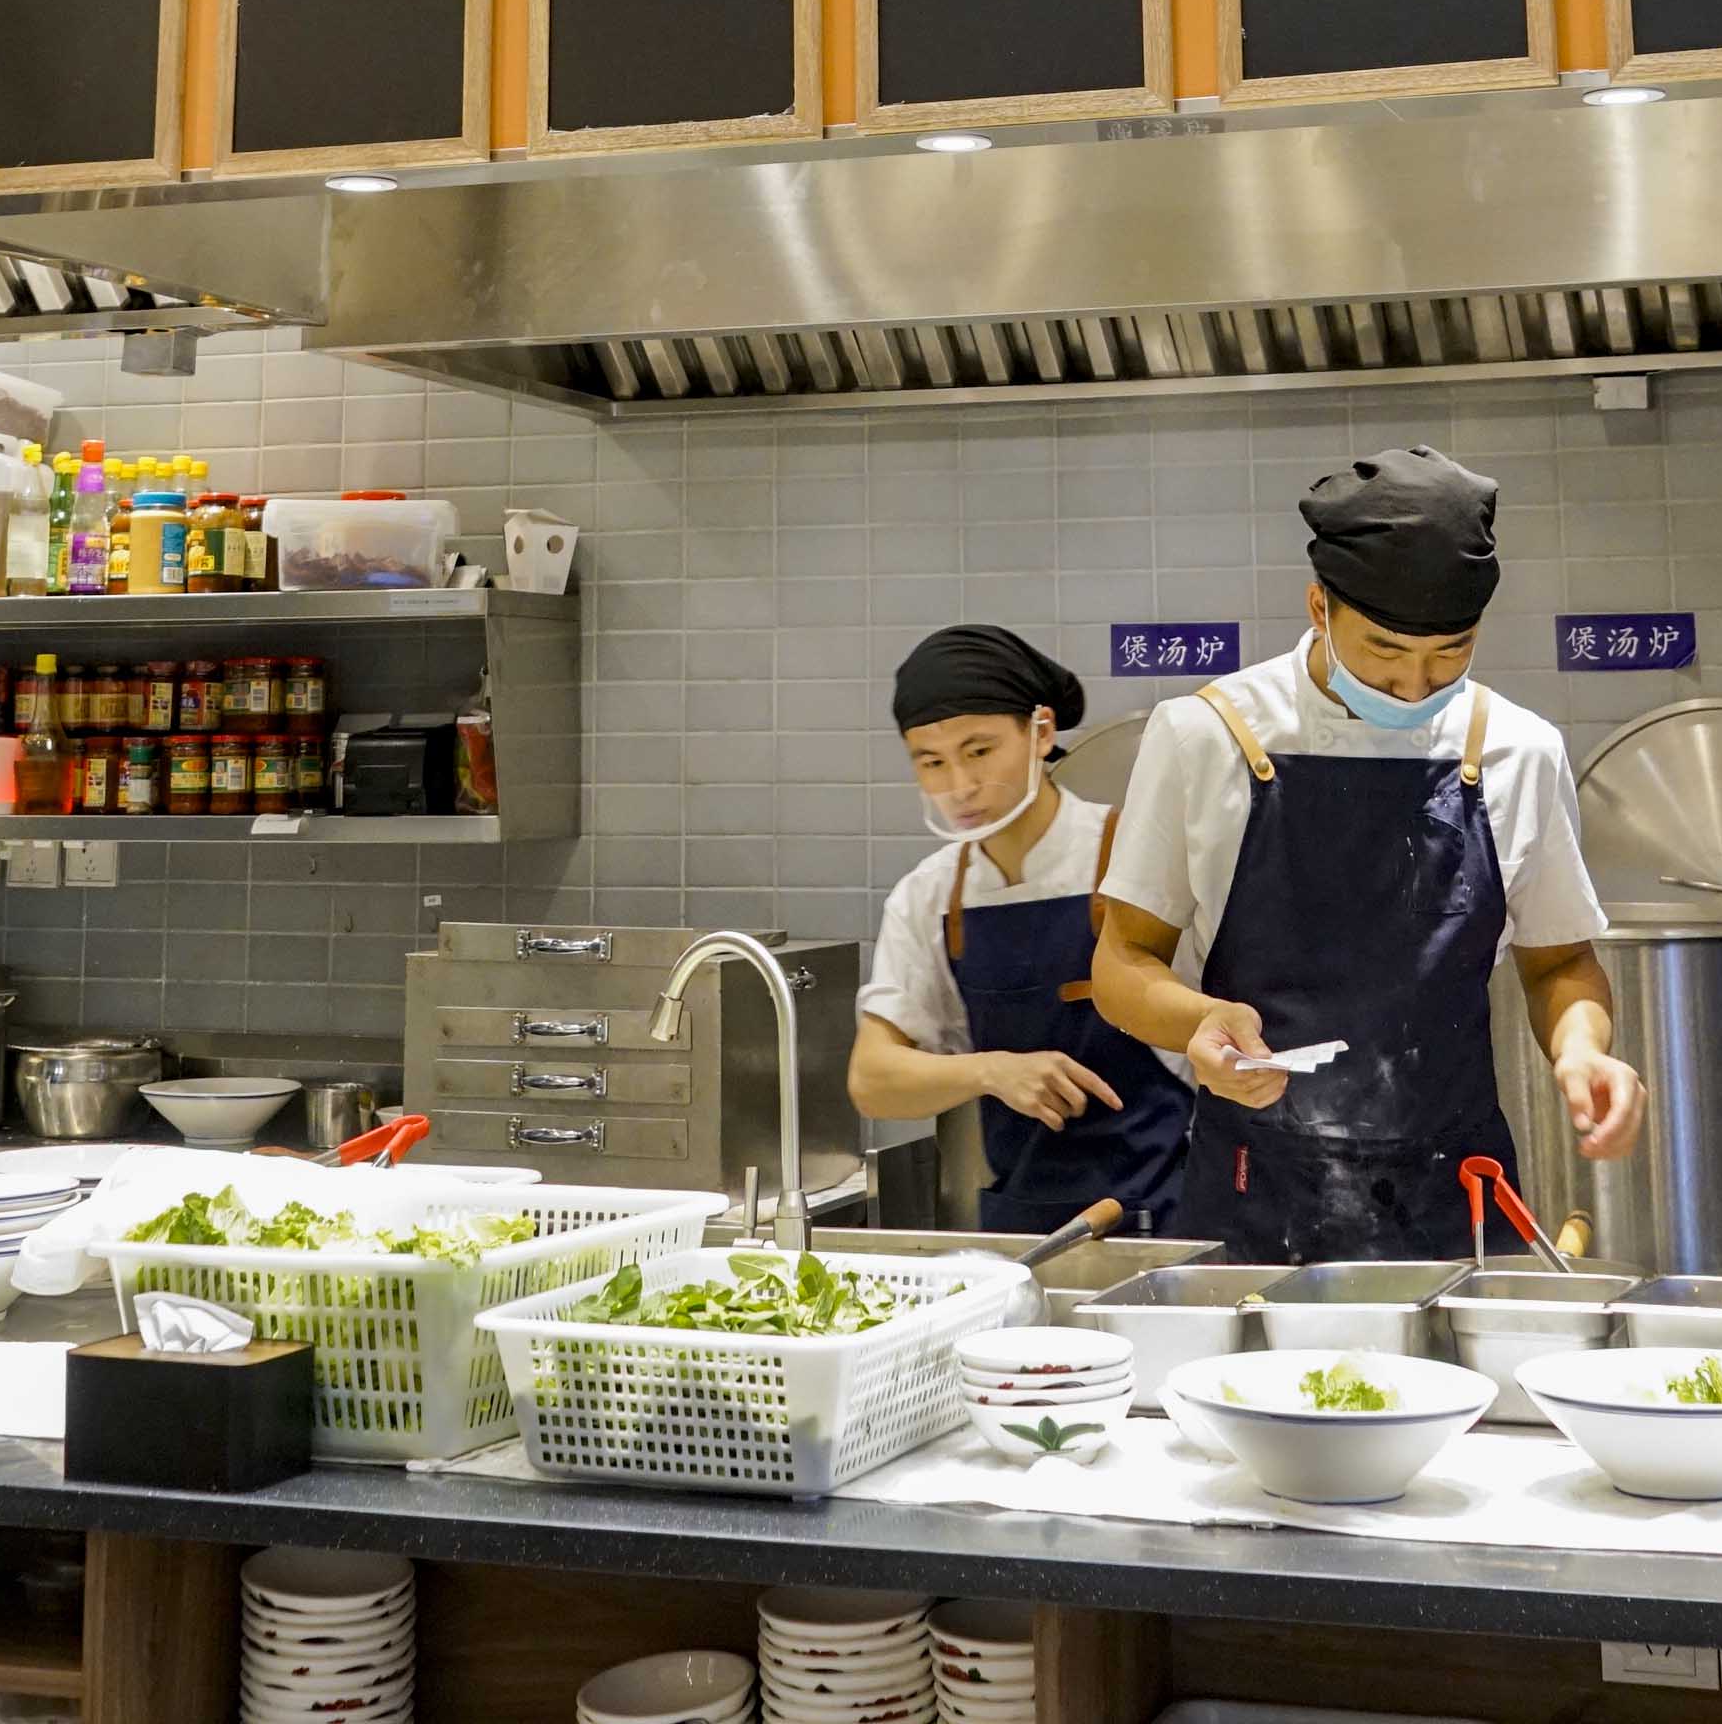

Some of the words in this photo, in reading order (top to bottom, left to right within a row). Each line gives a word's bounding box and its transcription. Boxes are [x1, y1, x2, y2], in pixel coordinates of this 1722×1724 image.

[1120, 635, 1225, 668] 煲汤炉
[1566, 625, 1680, 661] 煲汤炉
